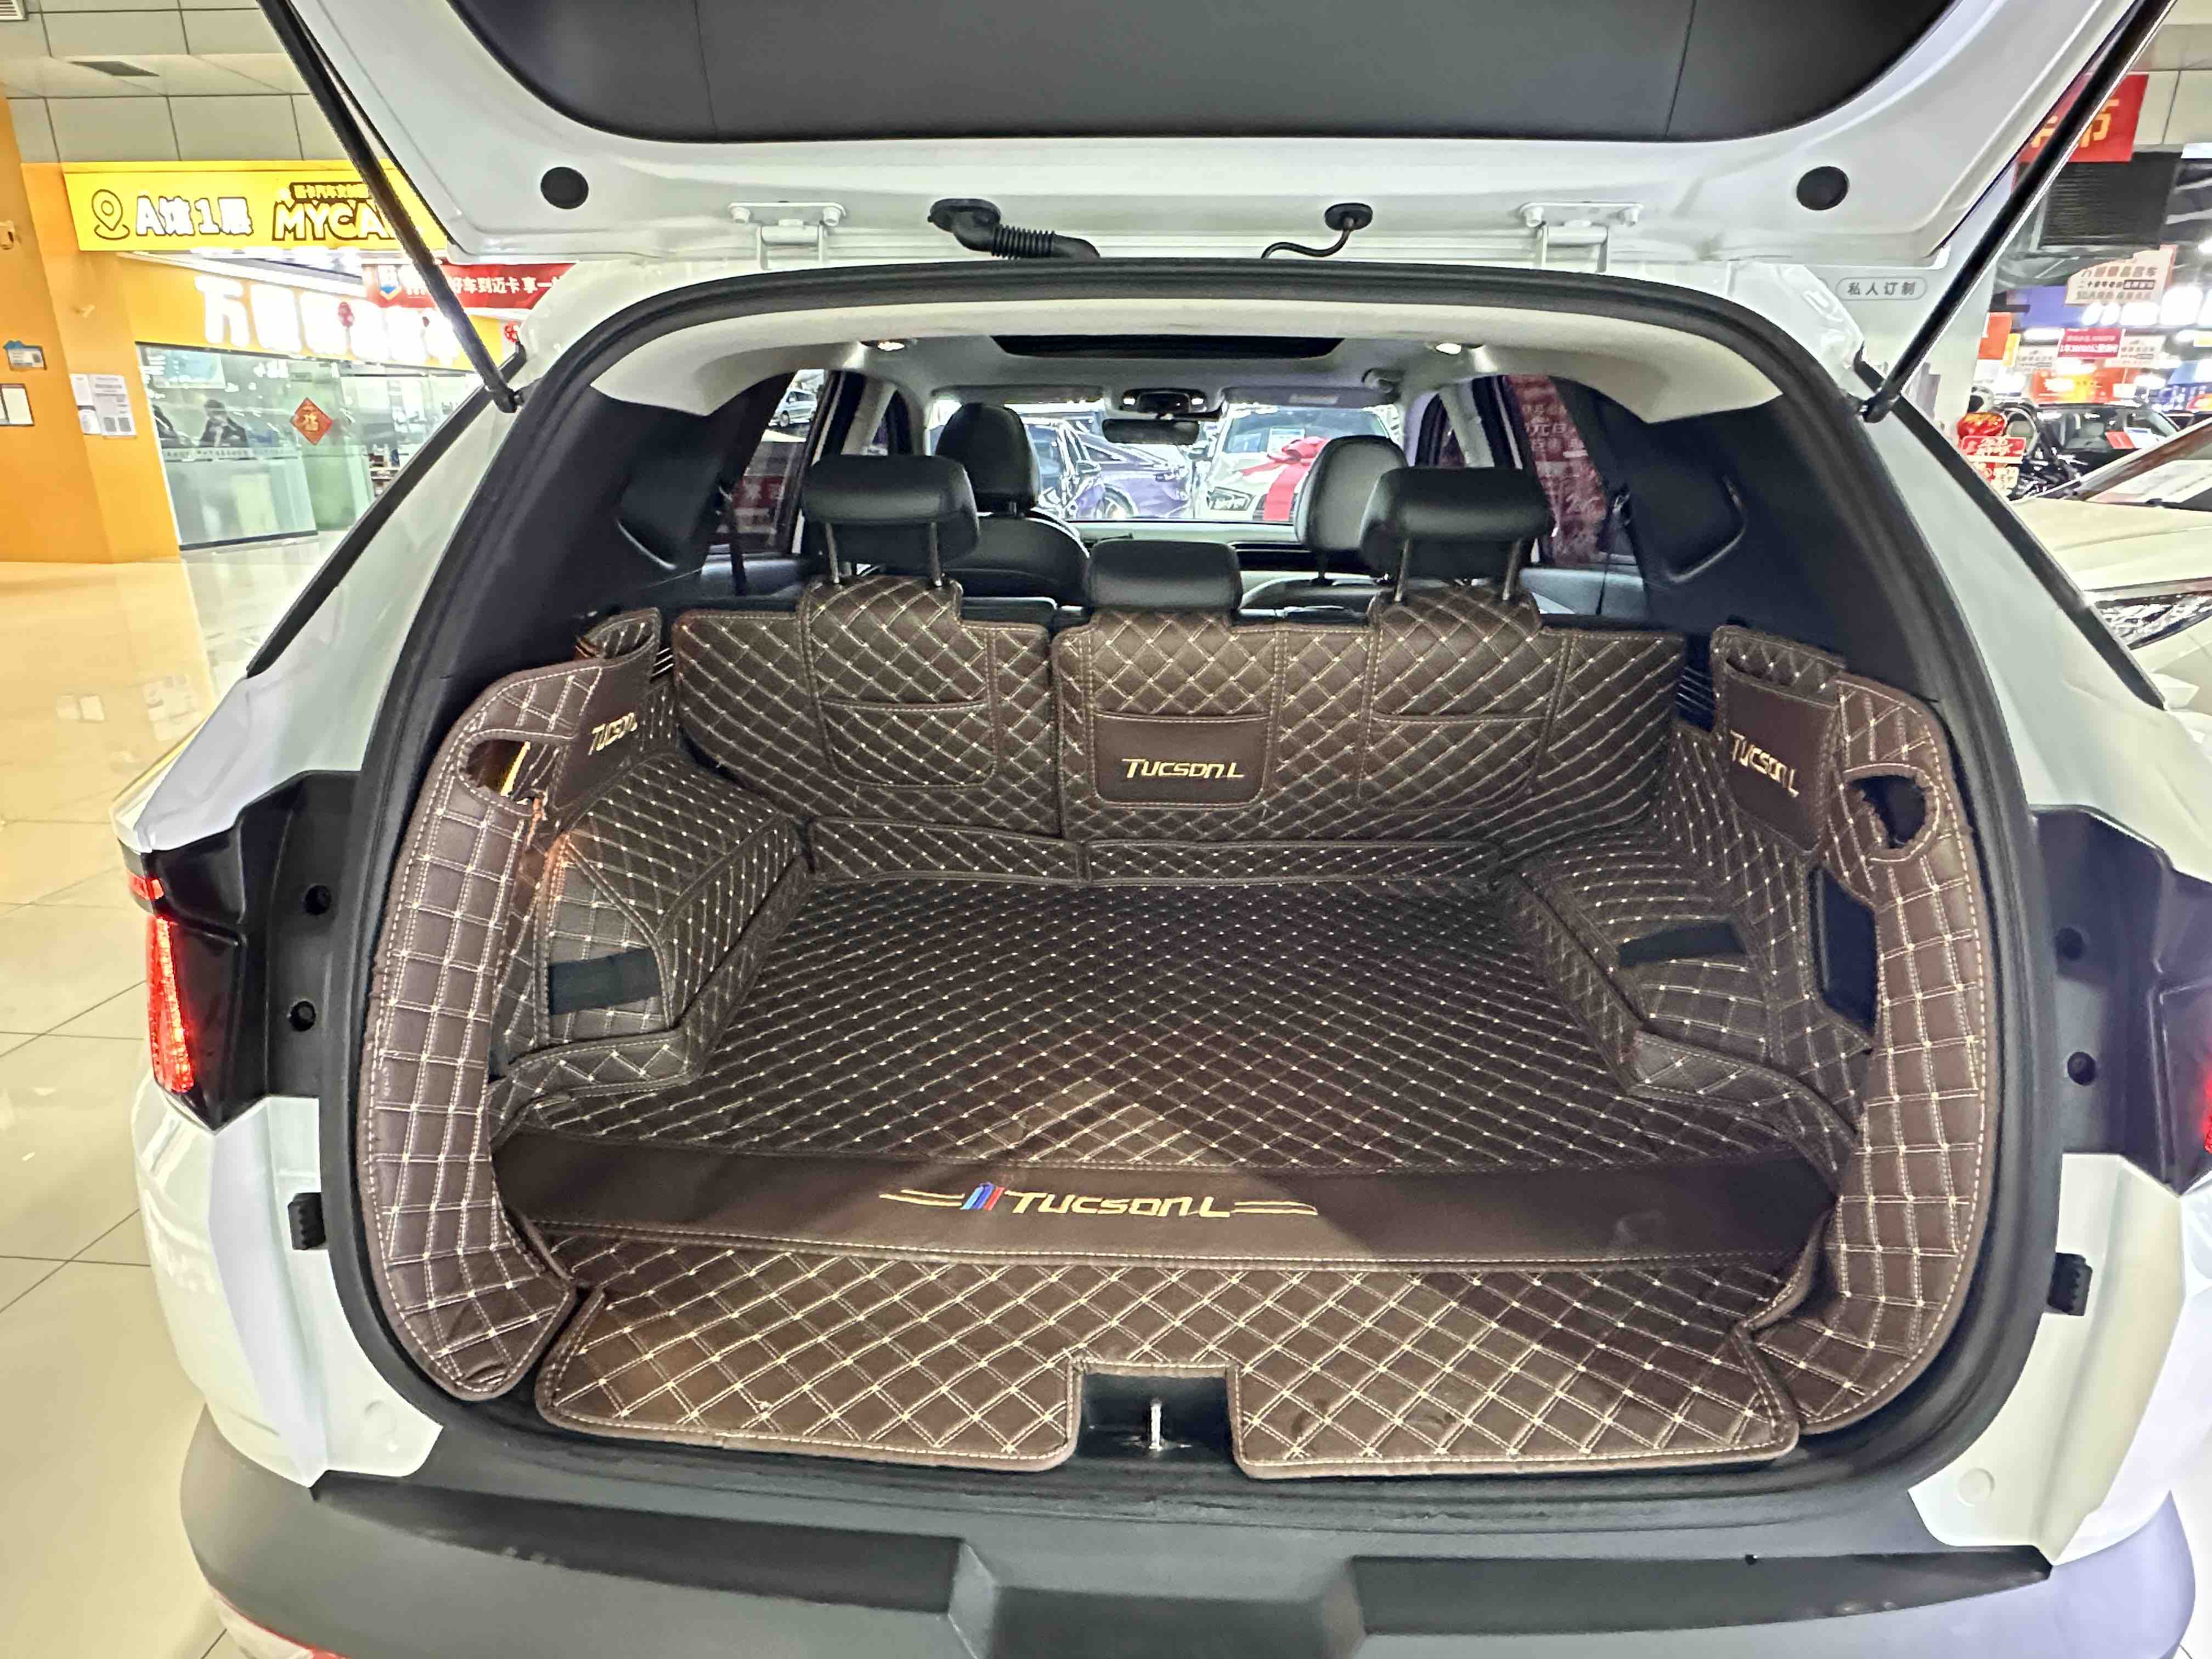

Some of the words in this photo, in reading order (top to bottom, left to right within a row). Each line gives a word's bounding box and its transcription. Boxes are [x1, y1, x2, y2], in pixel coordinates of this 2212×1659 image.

[272, 200, 399, 241] MYCA
[1847, 281, 1916, 296] 私人订制
[1121, 758, 1224, 778] TUCSON
[1003, 1189, 1193, 1217] TUCSON
